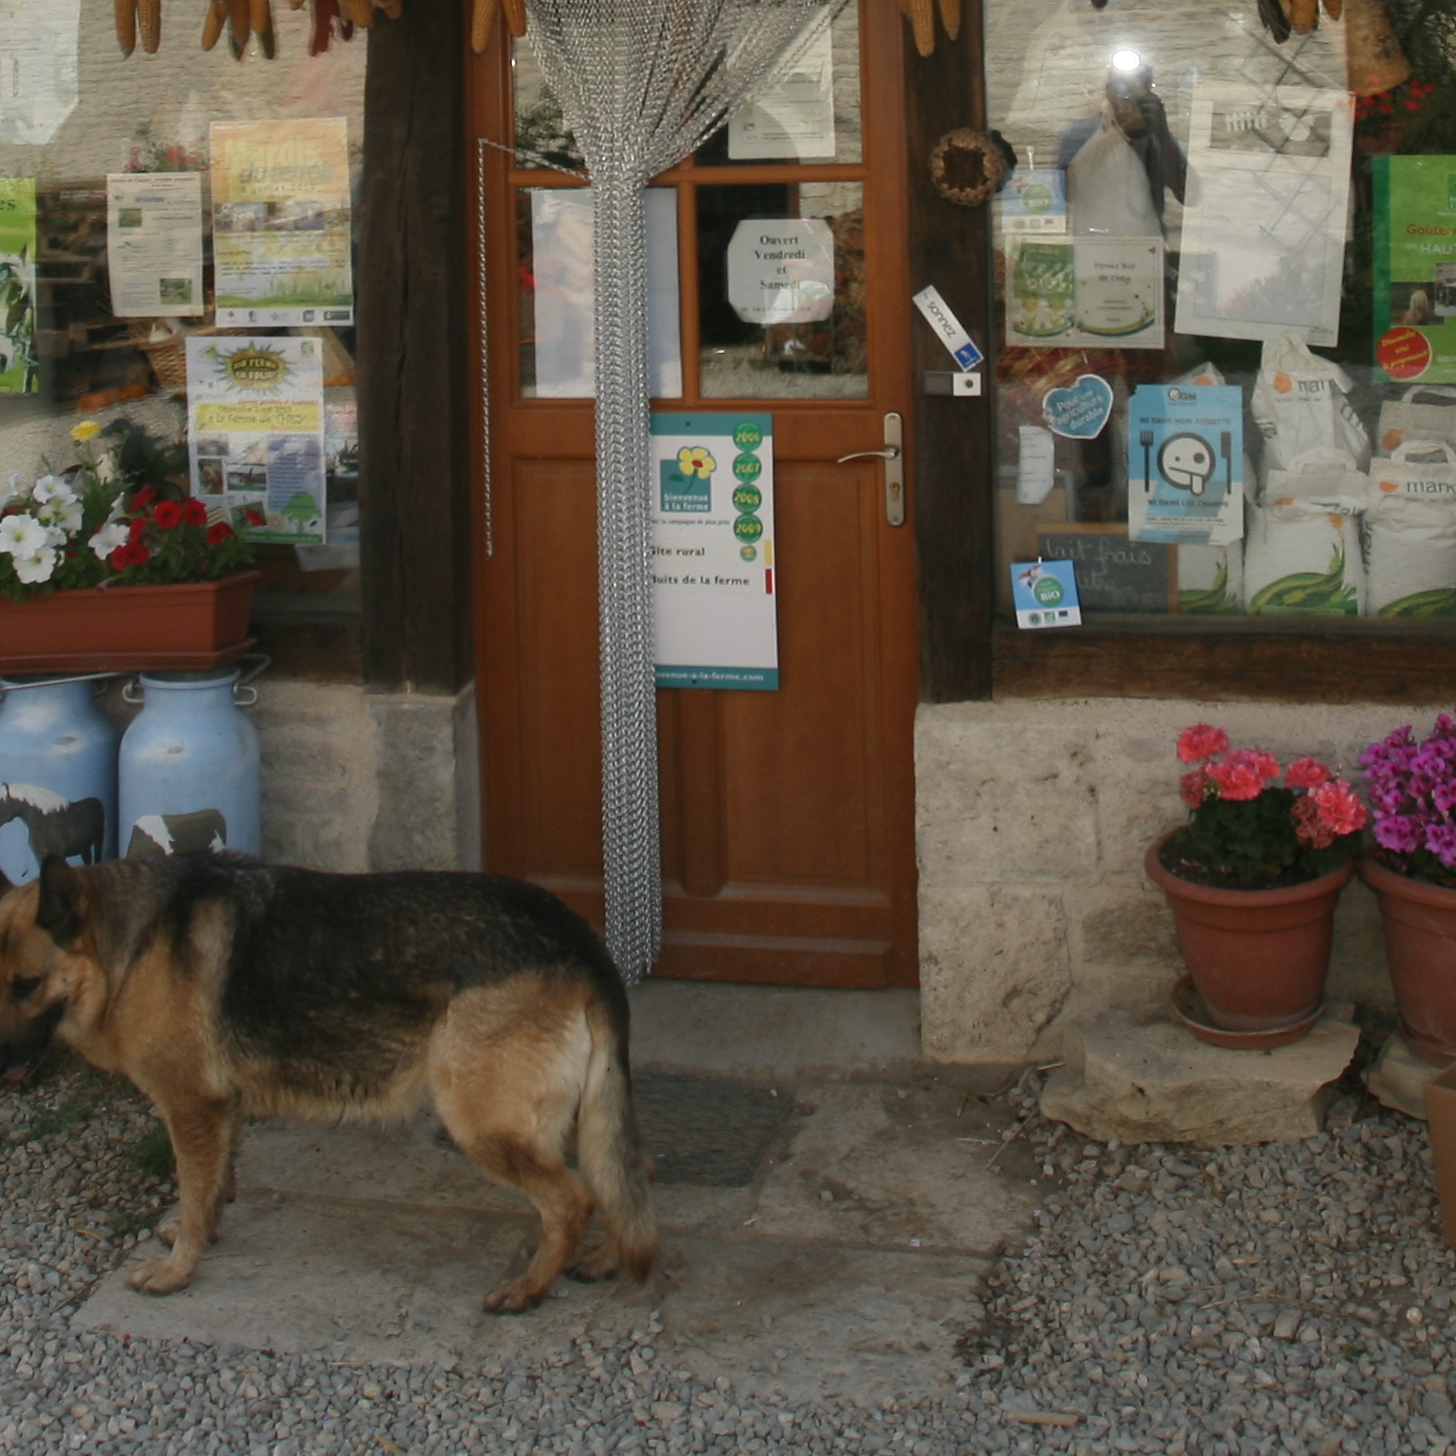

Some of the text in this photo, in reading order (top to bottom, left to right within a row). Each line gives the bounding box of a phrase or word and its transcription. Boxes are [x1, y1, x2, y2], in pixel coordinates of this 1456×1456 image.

[760, 235, 799, 245] Ouvert
[754, 250, 806, 260] Vendredi
[776, 266, 787, 275] et
[760, 280, 801, 289] Samedi
[927, 301, 956, 339] sonnez
[735, 463, 760, 474] 2007
[664, 493, 708, 502] bienvenue
[676, 546, 705, 556] rural
[682, 575, 696, 585] de
[700, 575, 710, 585] la
[714, 576, 750, 586] ferme
